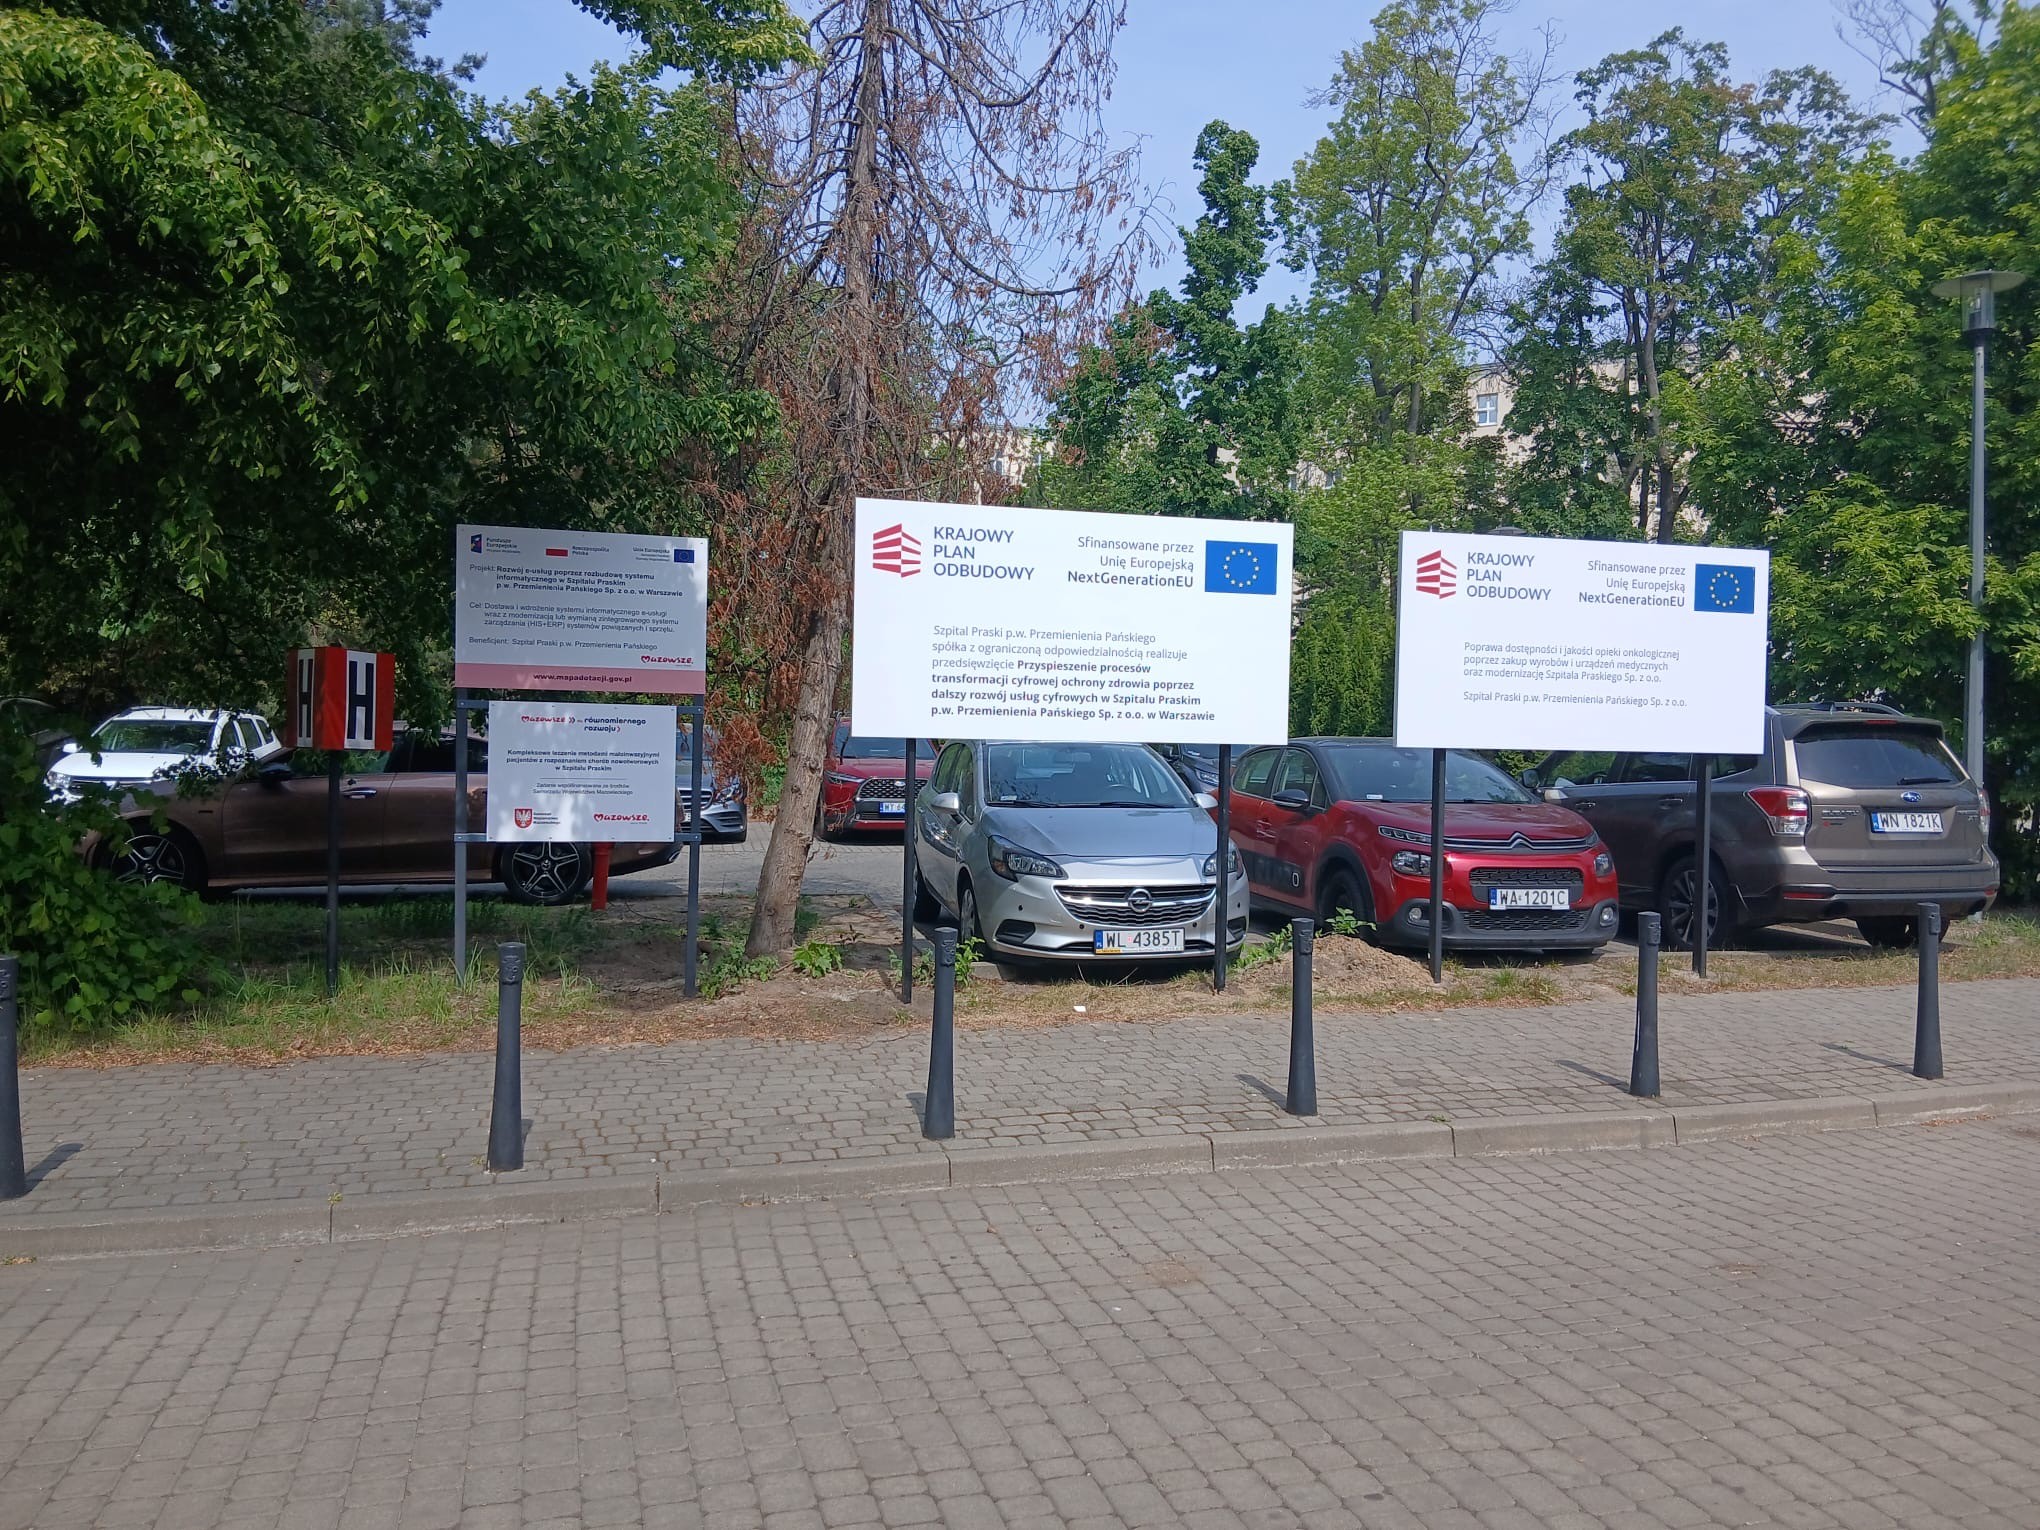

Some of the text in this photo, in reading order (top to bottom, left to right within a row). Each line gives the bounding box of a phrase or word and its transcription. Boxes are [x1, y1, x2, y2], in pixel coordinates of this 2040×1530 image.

[933, 526, 1014, 543] KRAJOWY
[933, 544, 975, 559] PLAN
[1078, 536, 1194, 556] Sfinansowane przez
[1100, 555, 1194, 574] Unię Europejską
[1467, 552, 1535, 568] KRAJOWY
[933, 562, 1034, 580] ODBUDOWY
[1467, 568, 1502, 582] PLAN
[1588, 560, 1686, 578] Sfinansowane przez
[1067, 570, 1194, 588] NextGenerationEU
[1606, 577, 1685, 595] Unię Europejską
[1467, 585, 1551, 600] ODBUDOWY
[1579, 592, 1685, 607] NextGenerationEU
[934, 626, 1156, 645] Szpital Praski p.w. Przemienienia Pańskiego
[932, 641, 1188, 662] spółka z ograniczoną odpowiedzialnością realizuje
[1464, 642, 1680, 661] Poprawa dostępności i jakości opieki onkologicznej
[932, 657, 1151, 676] przedsięwzięcie Przyspieszenie procesów
[1463, 656, 1668, 673] poprzez zakup wyrobów i urządzeń medycznych
[534, 673, 632, 683] www.mapadotacji.gov.pl
[932, 674, 1194, 693] transformacji cyfrowej ochrony zdrowia poprzez
[1463, 668, 1482, 676] oraz
[1484, 667, 1543, 681] modernizację
[1545, 669, 1578, 682] Szpitala
[1580, 670, 1622, 684] Praskiego
[1624, 672, 1637, 684] Sp.
[347, 660, 374, 740] H
[931, 689, 1201, 707] dalszy rozwój usług cyfrowych w Szpitalu Praskim
[1463, 691, 1492, 704] Szpital
[1494, 692, 1520, 701] Praski
[1522, 695, 1540, 705] p.w.
[1542, 693, 1603, 704] Przemienienia
[1605, 695, 1648, 708] Pańskiego
[1650, 696, 1663, 709] Sp.
[584, 716, 646, 725] równomiernego
[931, 707, 953, 719] p.w.
[957, 705, 1036, 717] Przemienienia
[1040, 707, 1095, 722] Pańskiego
[1098, 708, 1113, 722] Sp.
[1117, 711, 1122, 719] z
[1124, 711, 1143, 719] o.o.
[1158, 709, 1215, 720] Warszawie
[1880, 814, 1941, 828] WN 1821K
[1500, 890, 1518, 905] WA
[1524, 890, 1566, 905] 1201C
[1106, 933, 1126, 947] WL
[1133, 930, 1180, 946] 4385T
